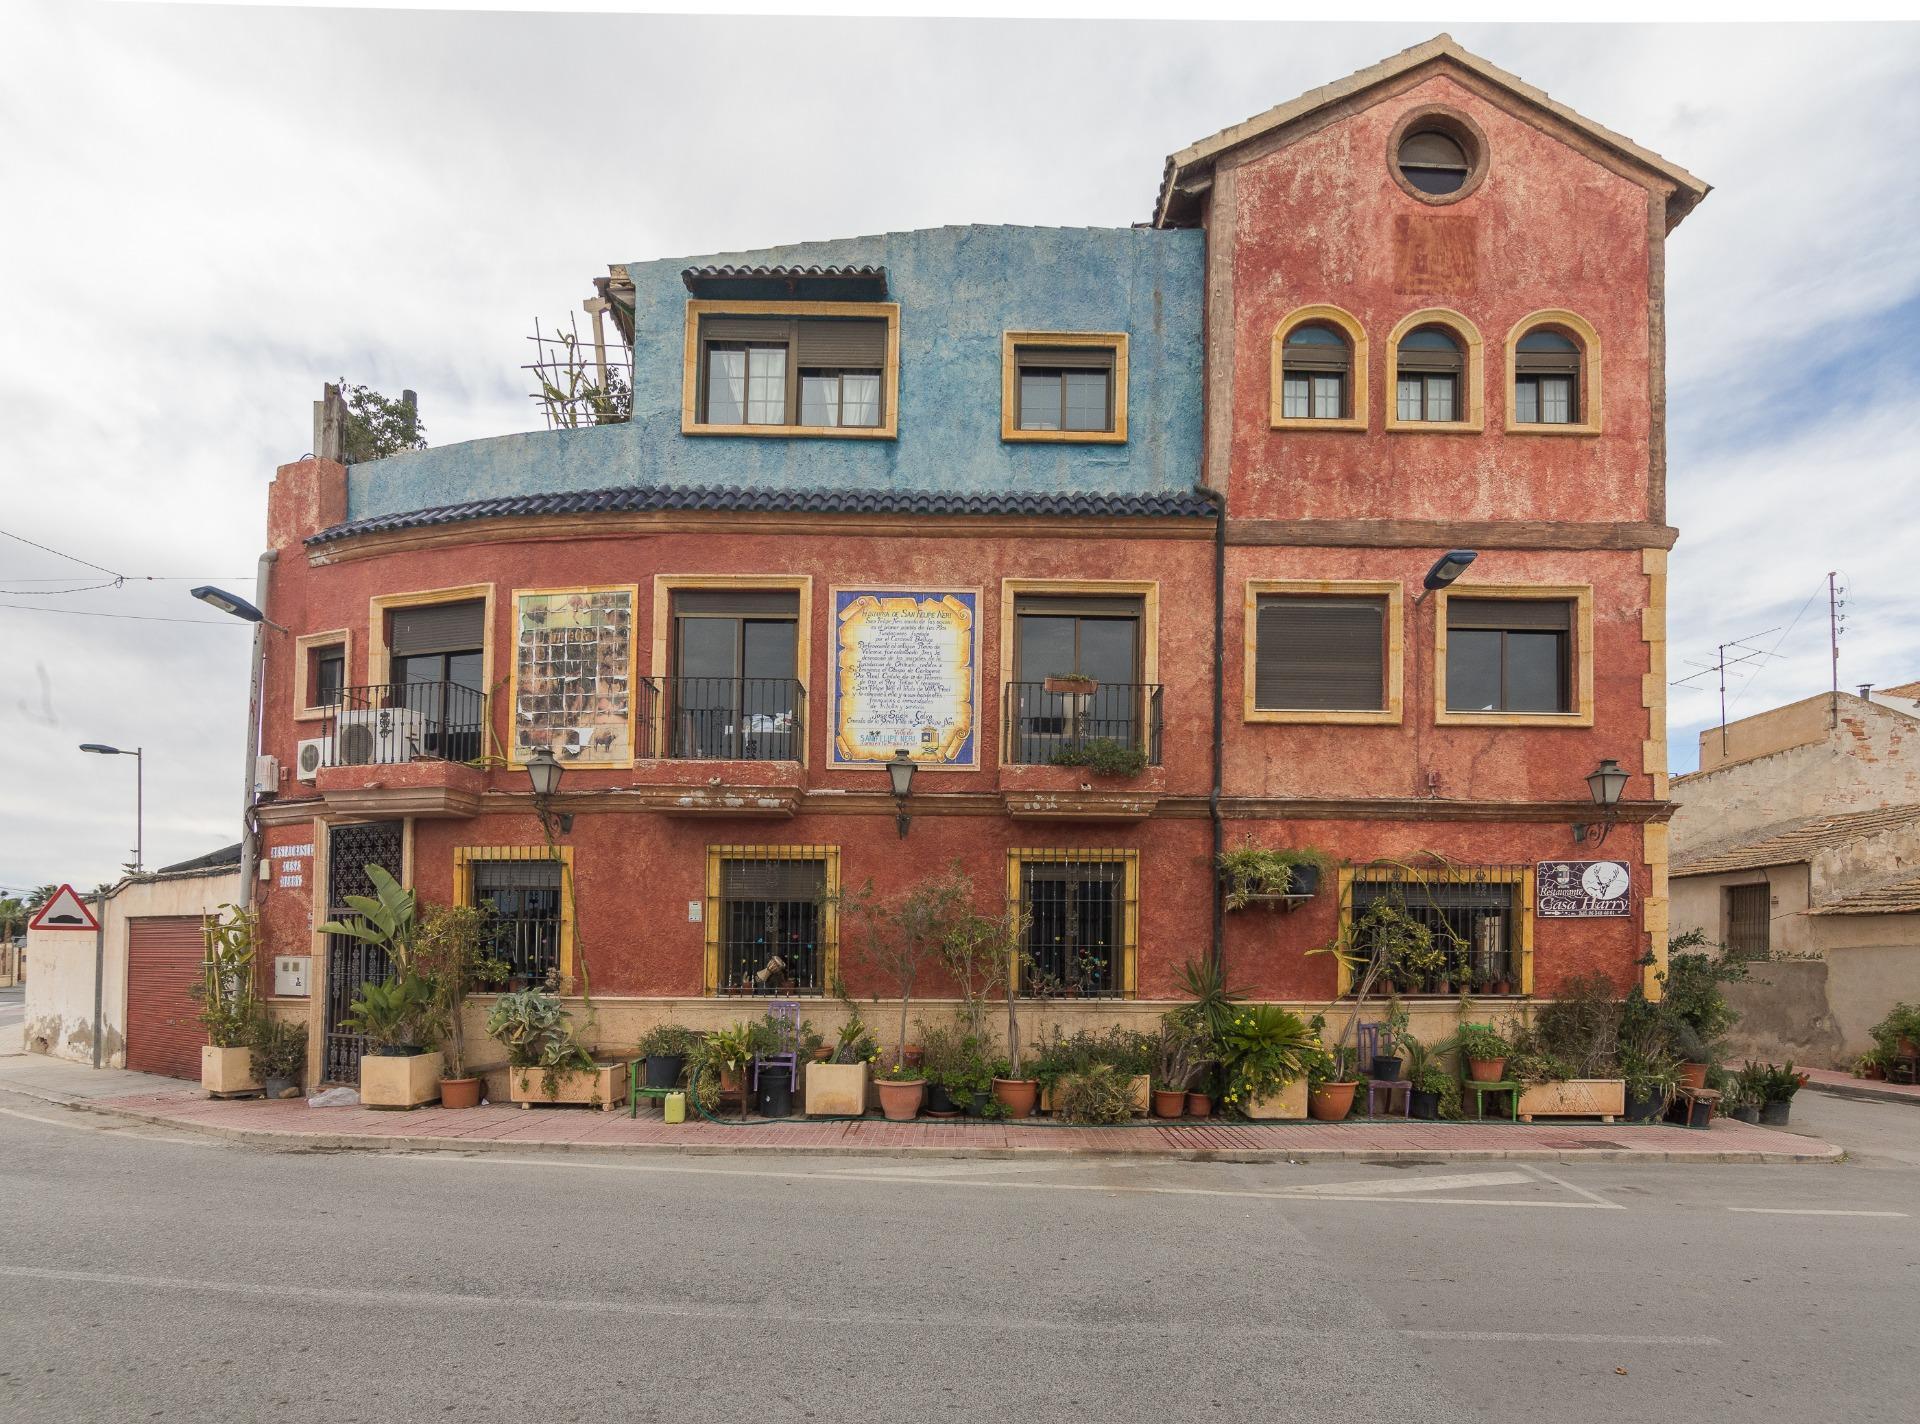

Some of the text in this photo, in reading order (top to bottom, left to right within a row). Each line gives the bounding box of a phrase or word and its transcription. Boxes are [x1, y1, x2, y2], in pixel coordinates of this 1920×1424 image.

[901, 609, 915, 618] SAN
[916, 610, 935, 619] FELIPE
[1540, 887, 1583, 896] Restaurante
[1540, 896, 1628, 913] Casa Harry
